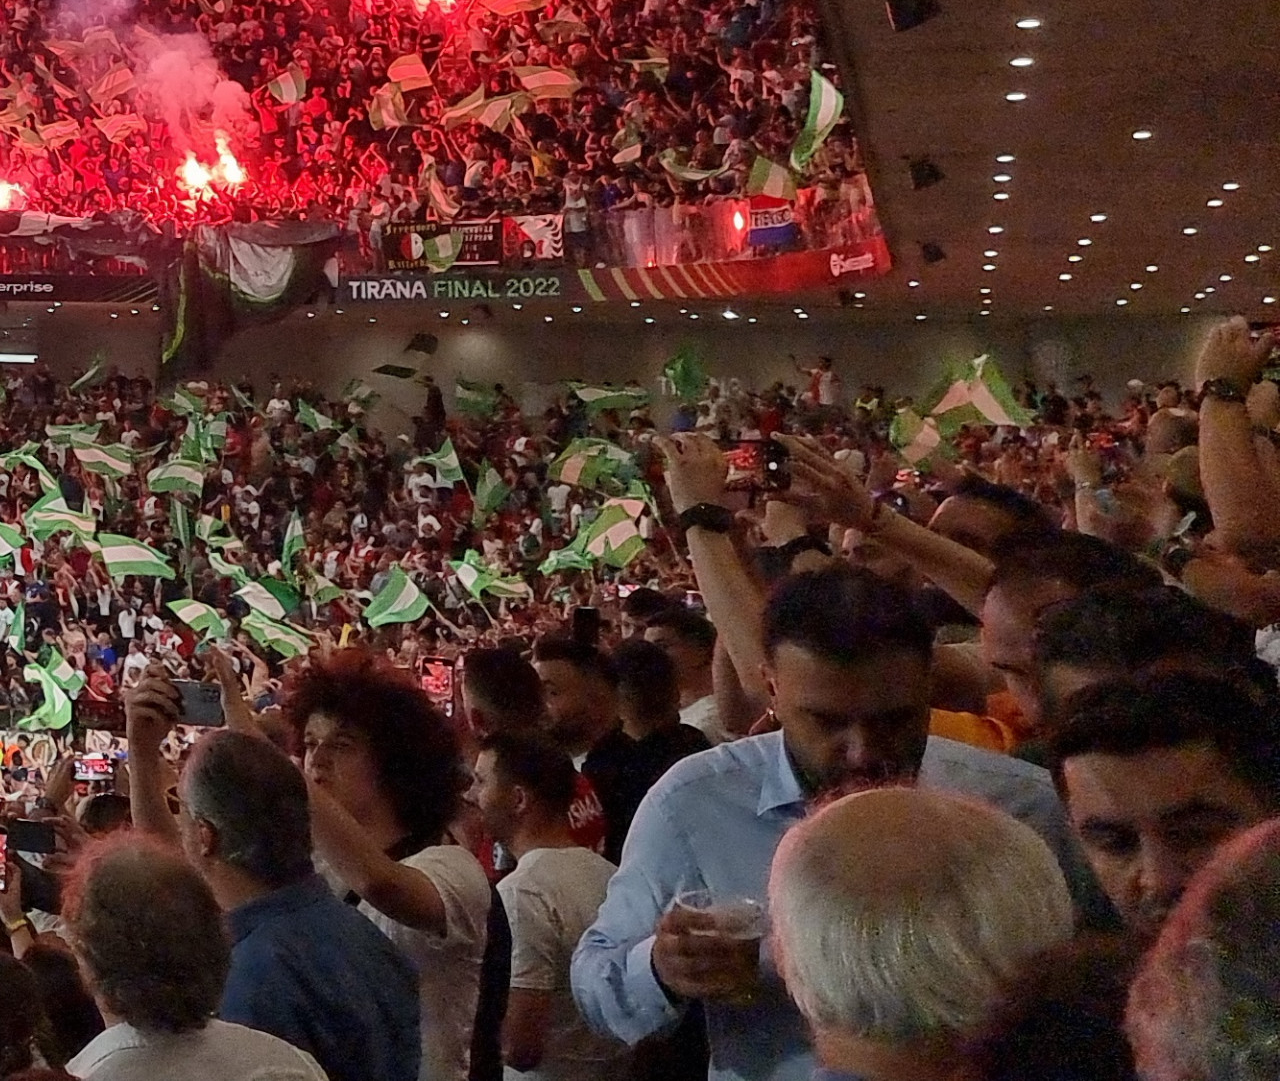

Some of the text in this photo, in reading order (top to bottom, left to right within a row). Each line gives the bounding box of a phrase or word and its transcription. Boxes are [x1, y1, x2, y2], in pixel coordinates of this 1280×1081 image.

[348, 276, 561, 299] TIRANA FINAL 2022
